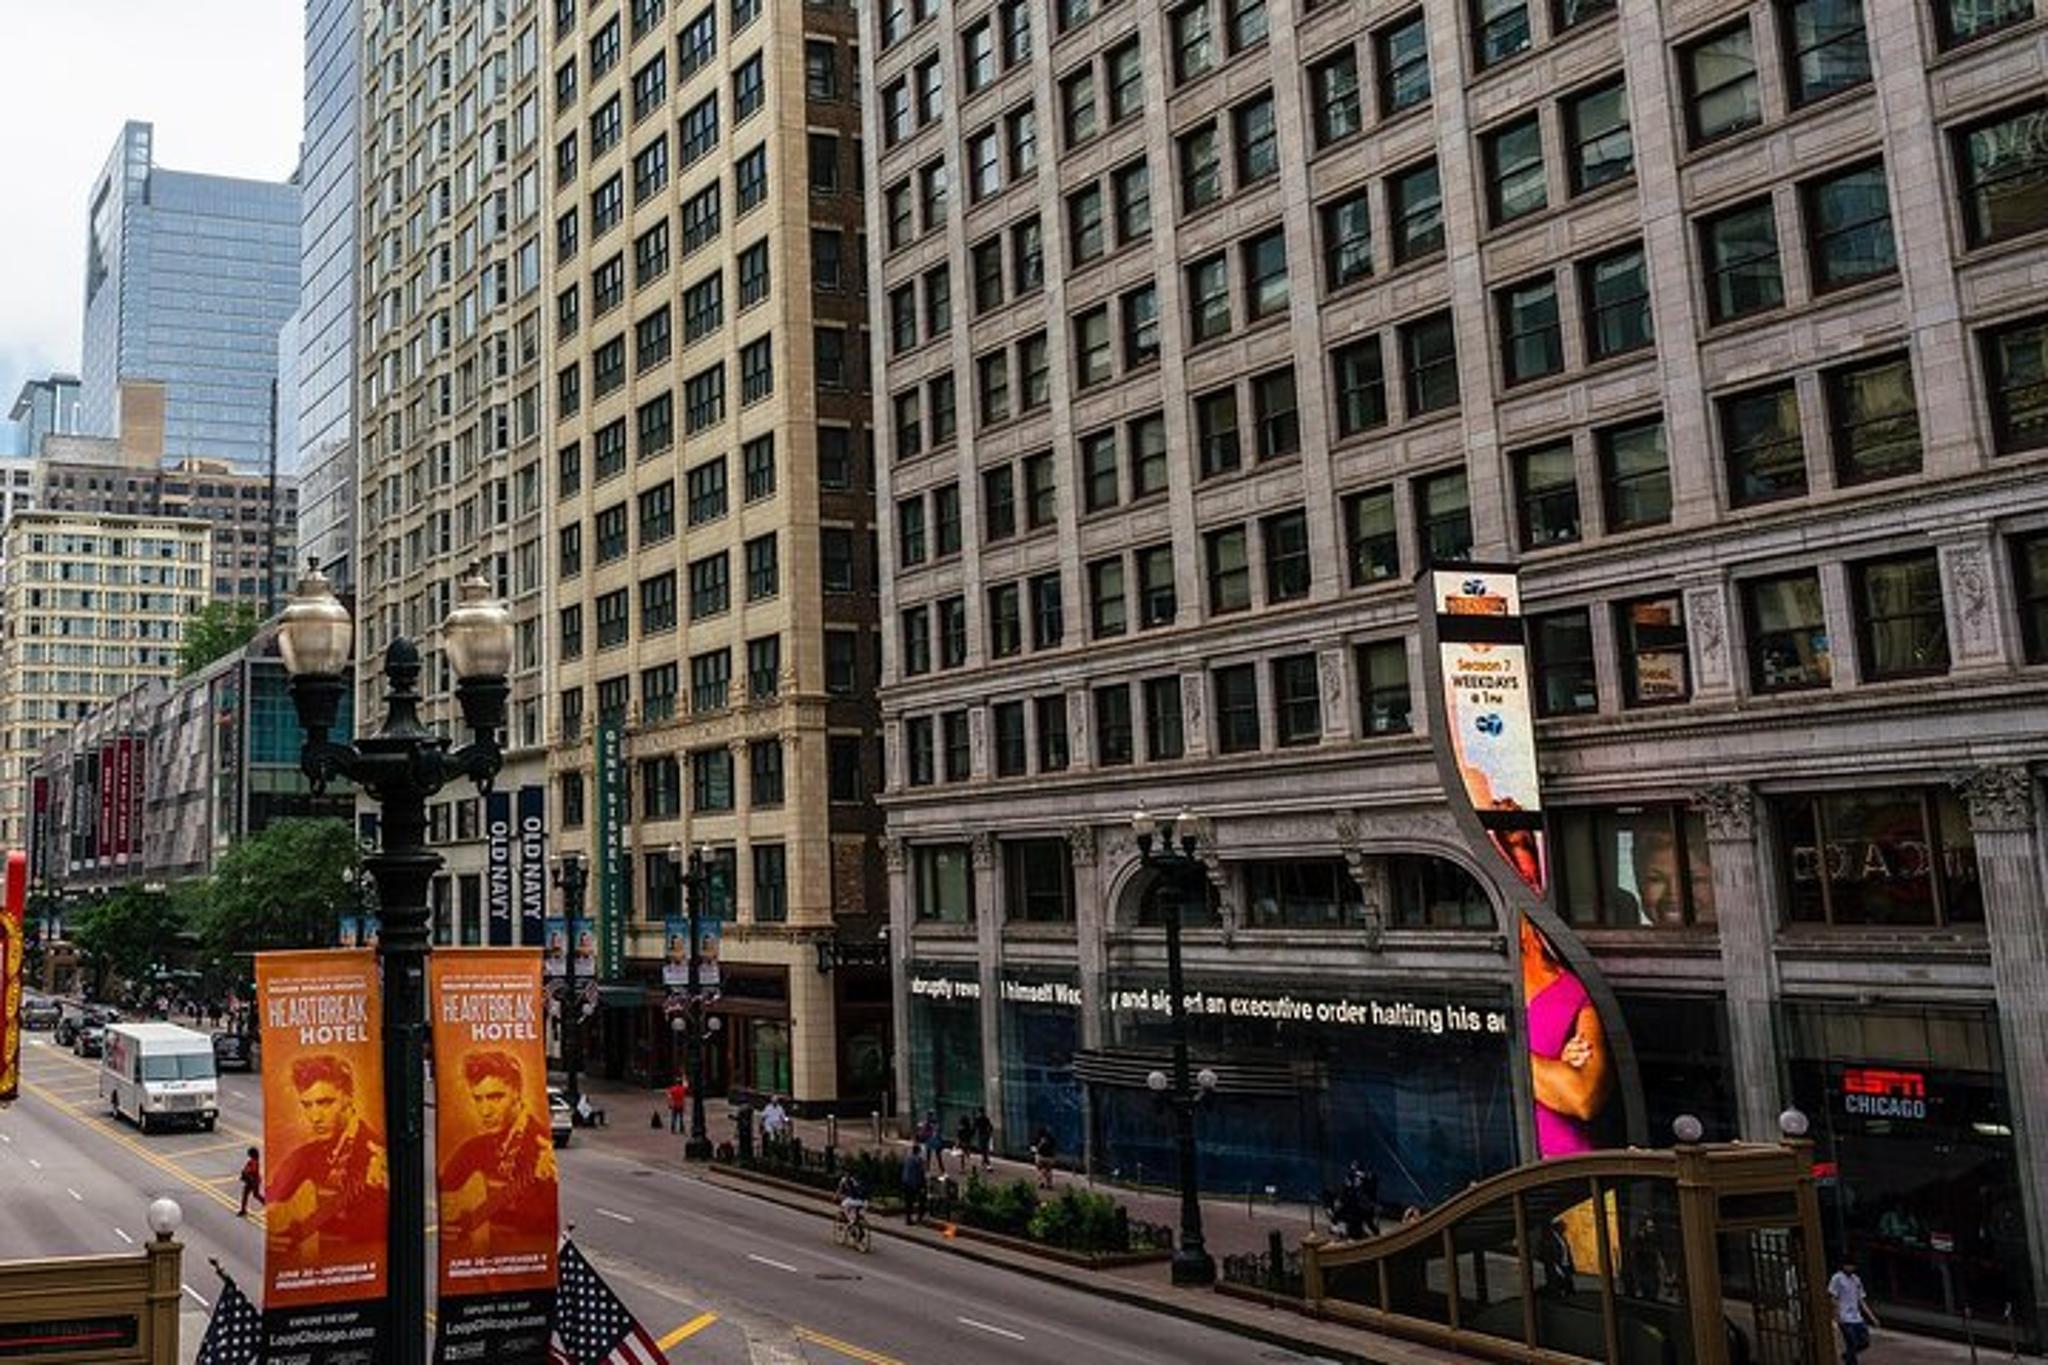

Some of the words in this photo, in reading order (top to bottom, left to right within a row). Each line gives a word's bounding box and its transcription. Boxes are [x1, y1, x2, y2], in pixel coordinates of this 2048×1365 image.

[1456, 658, 1502, 672] Season
[1452, 675, 1519, 690] WEEKDAYS
[491, 821, 508, 862] OLD
[523, 816, 542, 858] OLD
[491, 866, 510, 920] NAVY
[523, 863, 542, 919] NAVY
[268, 994, 368, 1028] HEARTBREAK
[441, 993, 536, 1022] HEARTBREAK
[1121, 988, 1149, 1011] and
[1230, 995, 1313, 1020] executive
[1316, 999, 1366, 1024] order
[1371, 1001, 1444, 1034] halting
[1446, 1005, 1481, 1032] his
[300, 1023, 369, 1045] HOTEL
[471, 1022, 538, 1041] HOTEL
[1844, 1069, 1925, 1097] ESPN
[1845, 1095, 1926, 1119] CHICAGO
[269, 1327, 376, 1347] LoopChicago.com
[446, 1315, 547, 1335] LoopChicago.com
